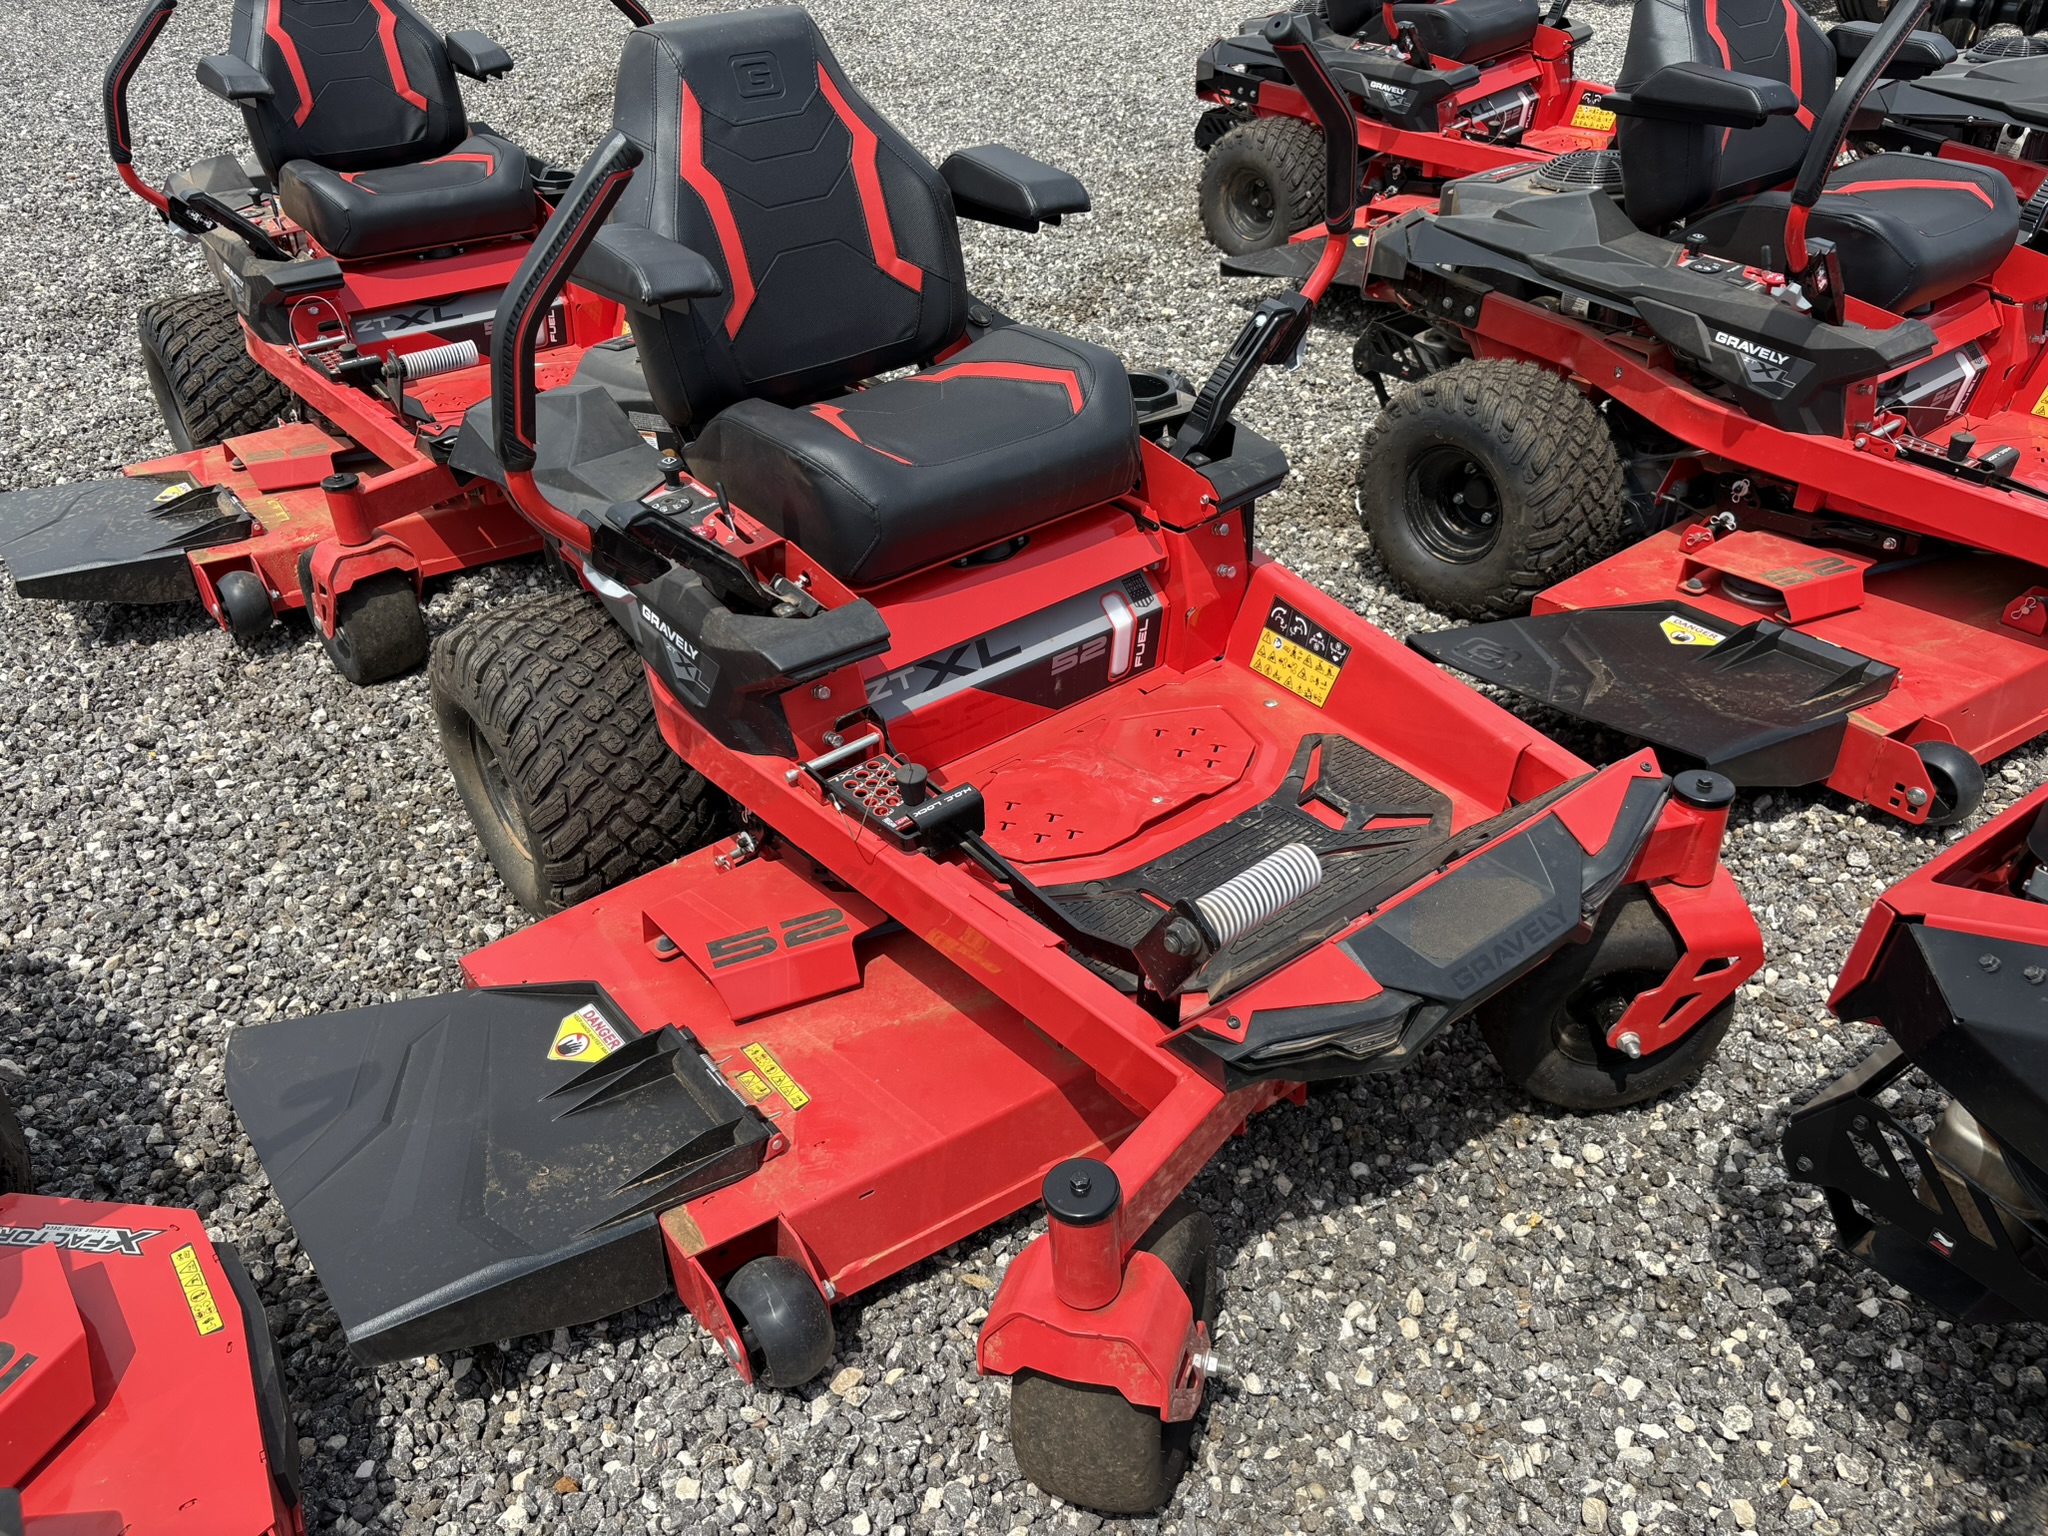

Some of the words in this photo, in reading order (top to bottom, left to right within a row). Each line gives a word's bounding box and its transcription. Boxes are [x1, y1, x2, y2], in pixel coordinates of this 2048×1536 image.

[1370, 81, 1407, 95] GRAVELY
[355, 316, 392, 333] ZT
[393, 306, 464, 332] XL
[549, 309, 558, 343] FUEL
[1715, 331, 1791, 365] GRAVELY
[1752, 361, 1797, 389] XL
[1759, 556, 1858, 587] 52
[642, 604, 699, 660] GRAVELY
[1133, 618, 1150, 668] FUEL
[1673, 618, 1719, 640] DANGER
[863, 666, 916, 704] ZT
[915, 637, 1023, 692] XL
[1050, 634, 1108, 677] 52
[674, 652, 711, 694] XL
[827, 770, 852, 783] XL
[912, 801, 942, 818] LOCK
[705, 907, 851, 969] 52
[1451, 902, 1569, 992] GRAVELY
[583, 1009, 621, 1050] DANGER
